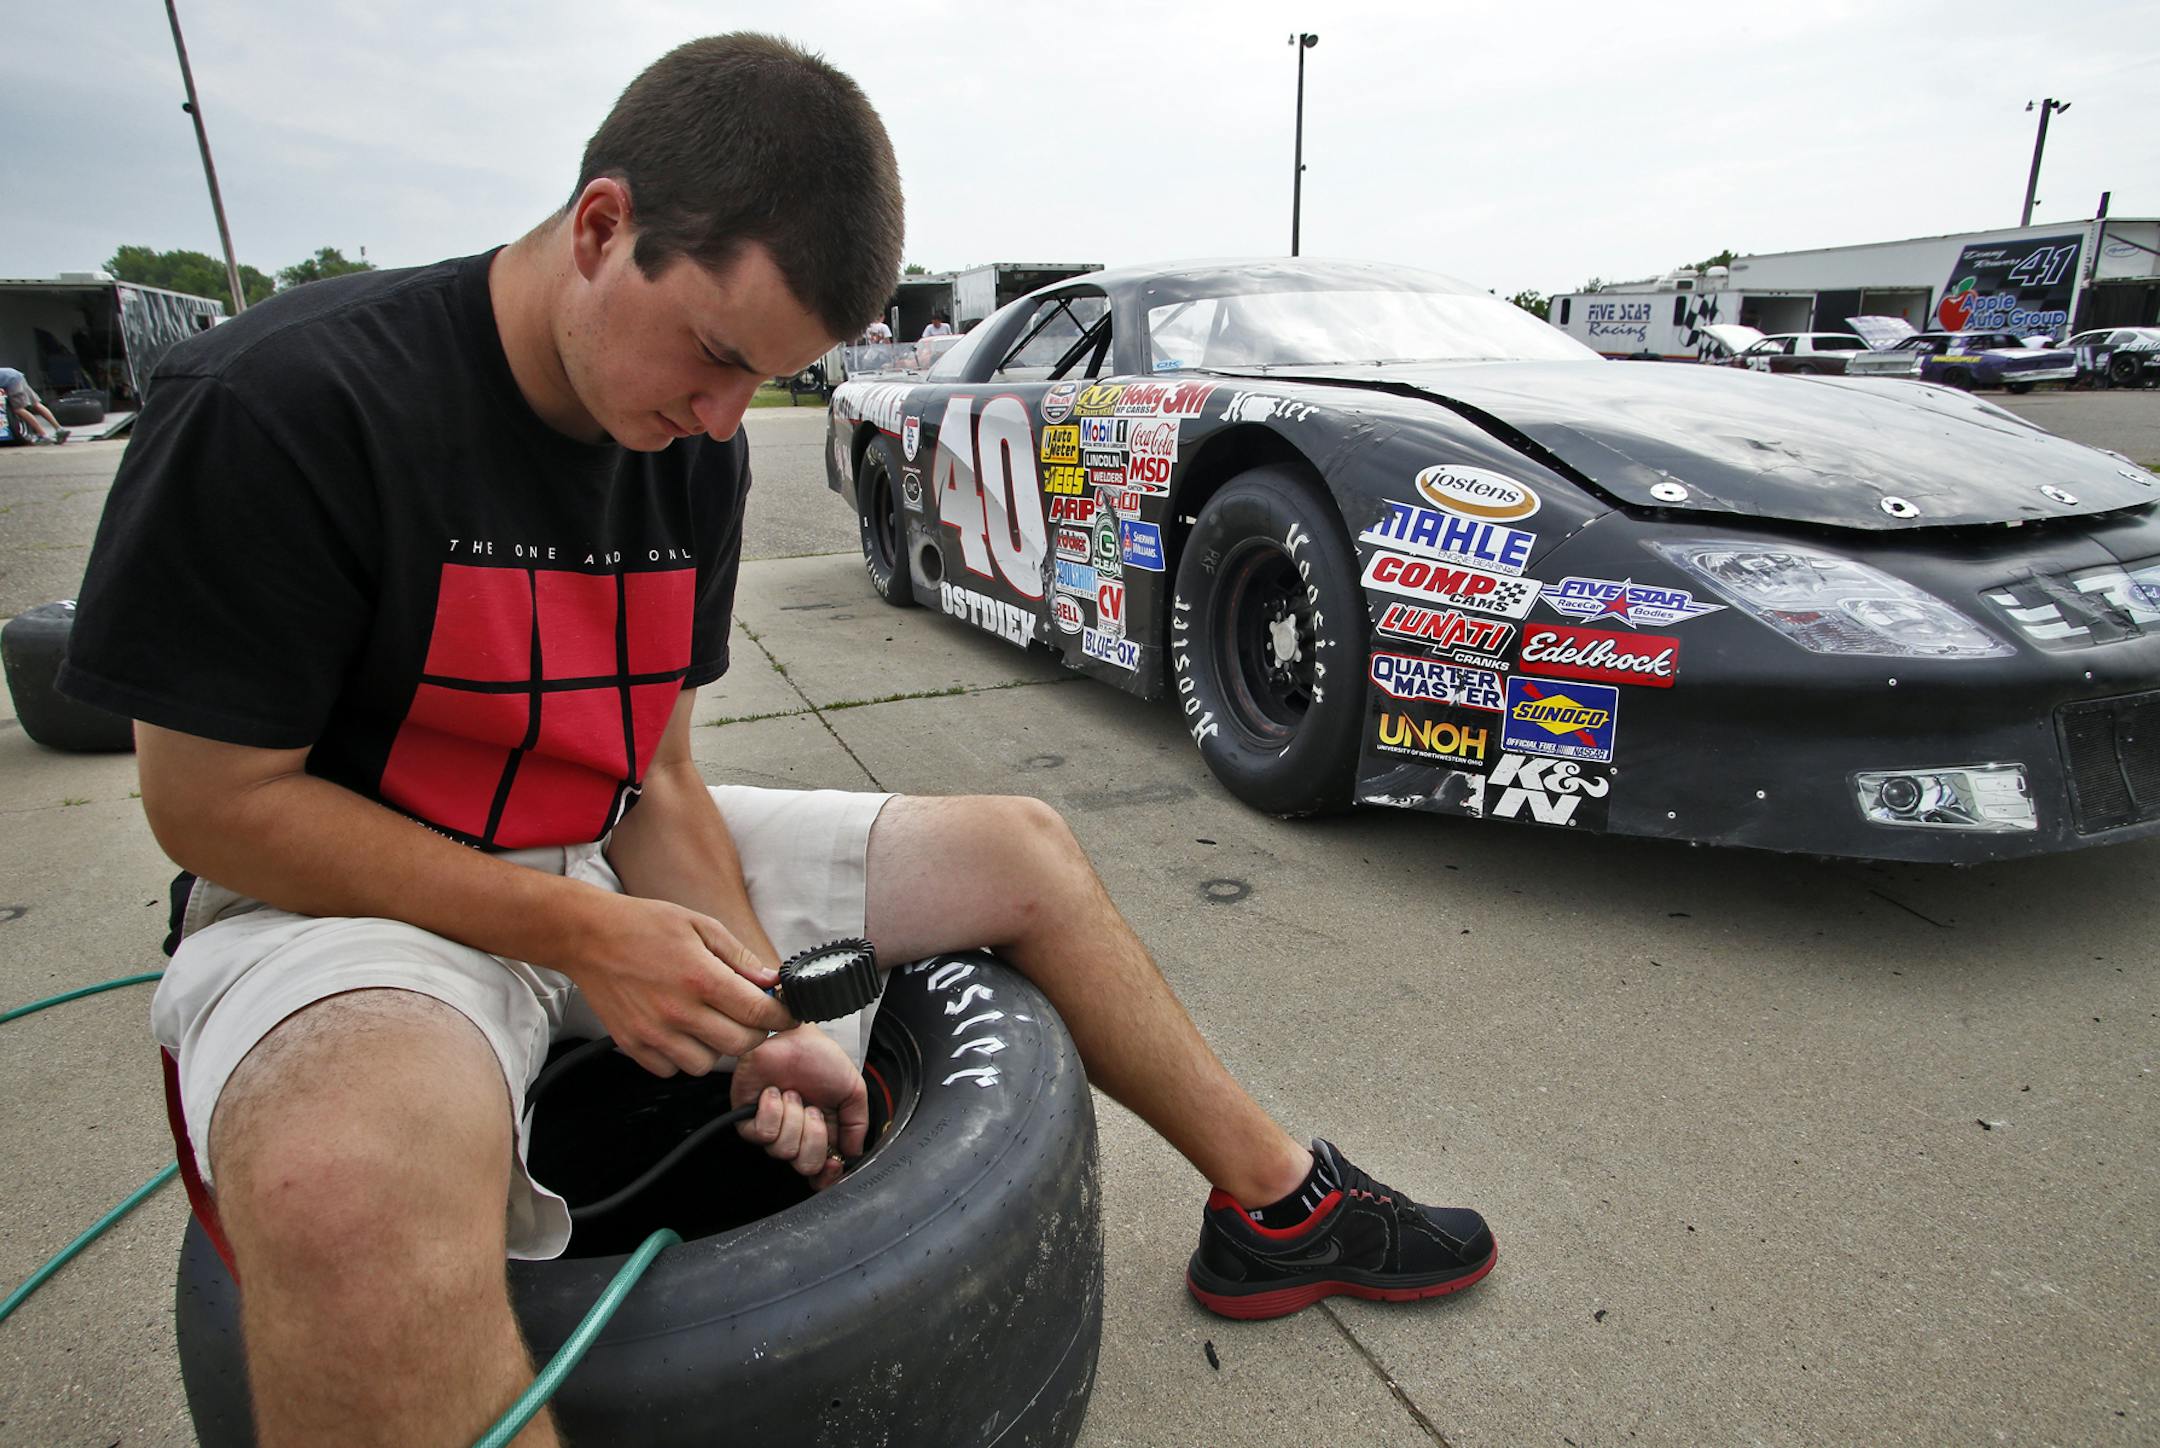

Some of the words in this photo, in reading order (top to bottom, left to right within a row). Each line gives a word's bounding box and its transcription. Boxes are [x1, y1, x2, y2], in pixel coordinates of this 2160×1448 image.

[2008, 244, 2078, 286] 41
[1588, 304, 1616, 320] FIVE
[1619, 303, 1651, 320] STAR
[1960, 291, 2016, 312] Apple
[1588, 322, 1648, 342] Racing
[1963, 311, 2005, 331] Auto
[2007, 308, 2067, 329] Group
[1119, 384, 1165, 413] Holley
[1126, 406, 1151, 414] CARBS
[1163, 382, 1214, 414] 3M
[1052, 429, 1072, 441] Auto
[1082, 419, 1113, 442] Mobil
[1051, 443, 1076, 457] Meter
[1086, 454, 1119, 467] LINCOLN
[1044, 466, 1085, 495] JEGS
[1093, 470, 1124, 484] WELDERS
[1129, 456, 1170, 482] MSD
[934, 393, 1047, 601] 40
[1427, 467, 1519, 504] jostens
[1051, 499, 1094, 521] ARP
[1099, 531, 1116, 557] G
[1365, 503, 1533, 568] MAHLE
[449, 540, 494, 555] THE
[515, 544, 557, 560] ONE
[584, 551, 621, 565] AND
[1094, 557, 1122, 573] CLEAN
[1438, 551, 1471, 564] ENGINE
[1372, 557, 1498, 597] COMP
[1099, 585, 1123, 621] CV
[1449, 594, 1510, 613] CAMS
[1562, 581, 1619, 600] FIVE
[1626, 586, 1690, 610] STAR
[941, 581, 1037, 649] OSTDIEK
[1056, 602, 1079, 623] BELL
[1557, 598, 1602, 612] RaceCar
[1633, 607, 1675, 620] Bodies
[1380, 605, 1507, 652] LUNATI
[1085, 631, 1113, 659] BLUE
[1521, 631, 1673, 678] Edelbrock
[1174, 595, 1218, 748] Hoosier
[1373, 656, 1497, 690] QUARTER
[1454, 653, 1511, 672] CRANKS
[1393, 675, 1502, 709] MASTER
[1516, 703, 1606, 726] SUNOCO
[1379, 711, 1488, 760] UNOH
[1506, 737, 1537, 748] OFFICIAL
[1538, 742, 1556, 752] FUEL
[1377, 744, 1411, 754] UNIVERSITY
[1419, 750, 1467, 763] NORTHWESTERN
[1467, 759, 1484, 767] OHIO
[904, 957, 1034, 1088] osier
